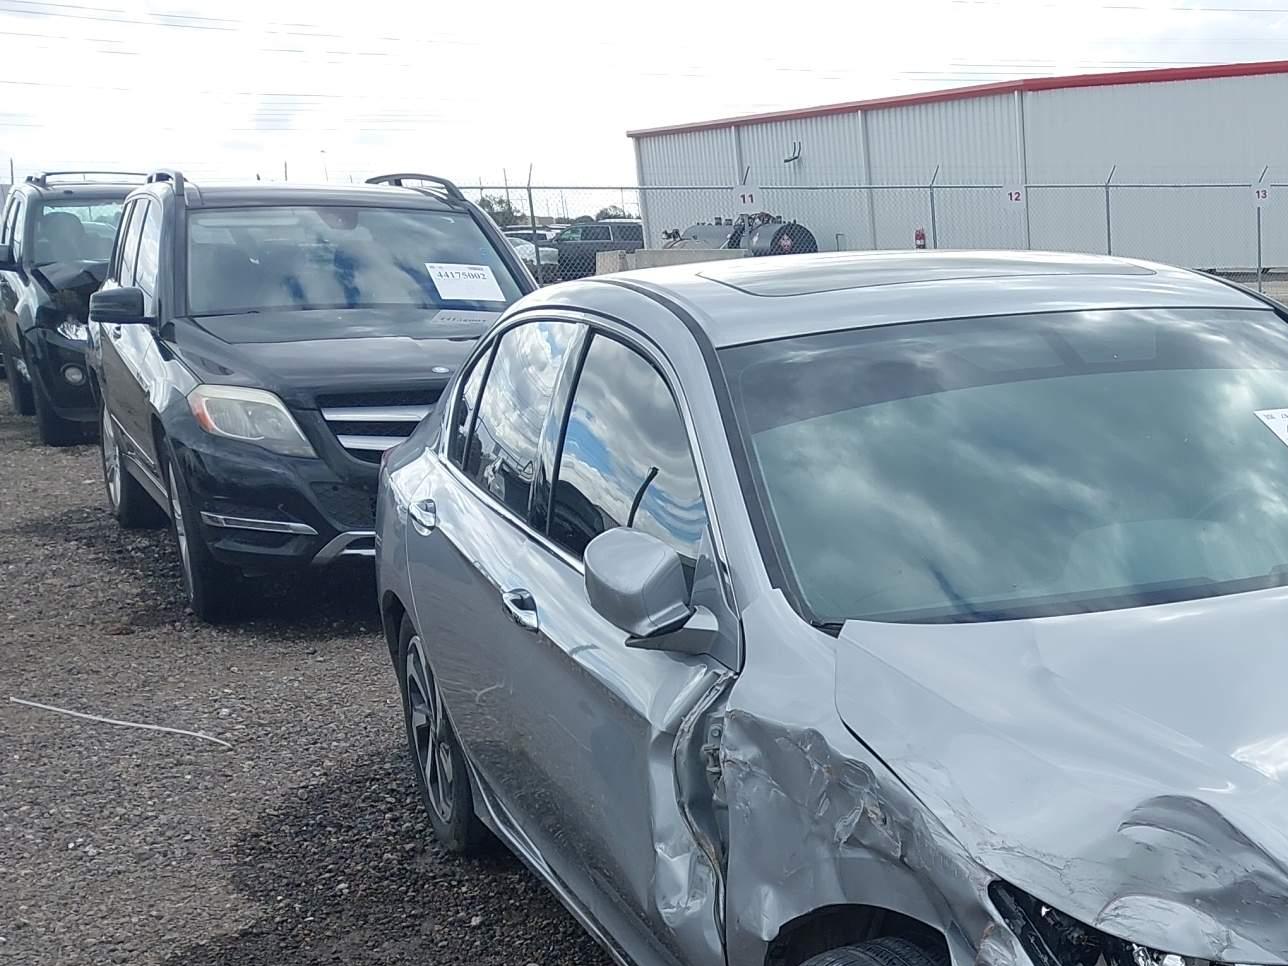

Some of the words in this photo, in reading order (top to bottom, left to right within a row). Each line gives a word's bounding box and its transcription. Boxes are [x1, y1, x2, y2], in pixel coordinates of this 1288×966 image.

[740, 193, 754, 204] 11
[1008, 191, 1021, 202] 12
[1255, 190, 1268, 200] 13
